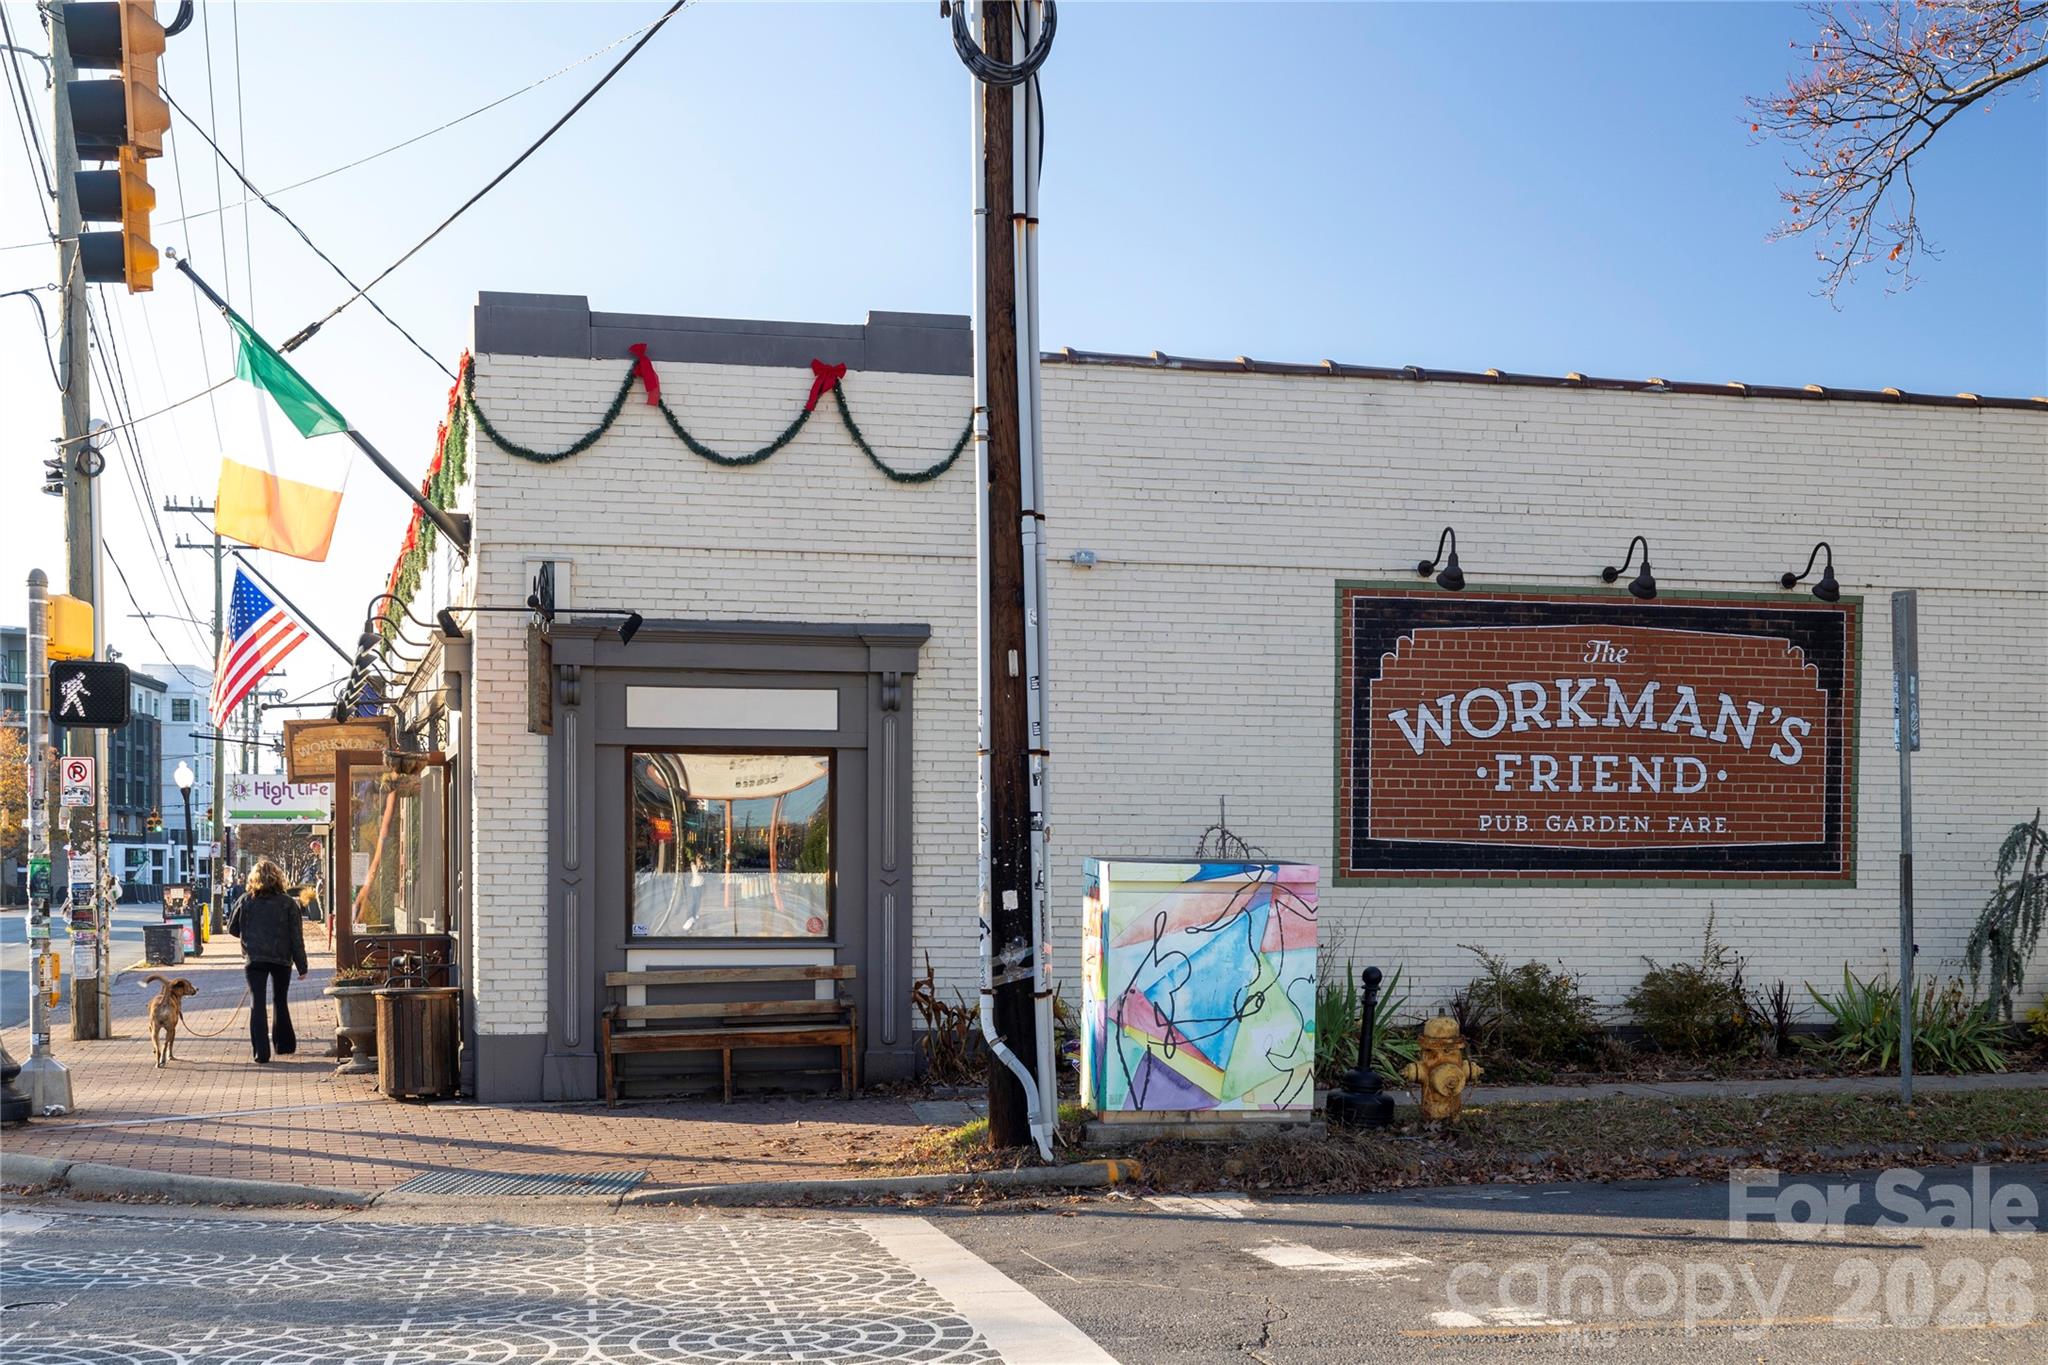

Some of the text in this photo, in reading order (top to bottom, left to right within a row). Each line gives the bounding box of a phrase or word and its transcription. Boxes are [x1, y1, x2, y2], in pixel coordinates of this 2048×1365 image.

[1583, 639, 1629, 664] The
[1388, 677, 1811, 766] WORKMAN'S
[1494, 754, 1708, 793] FRIEND
[255, 781, 295, 805] High
